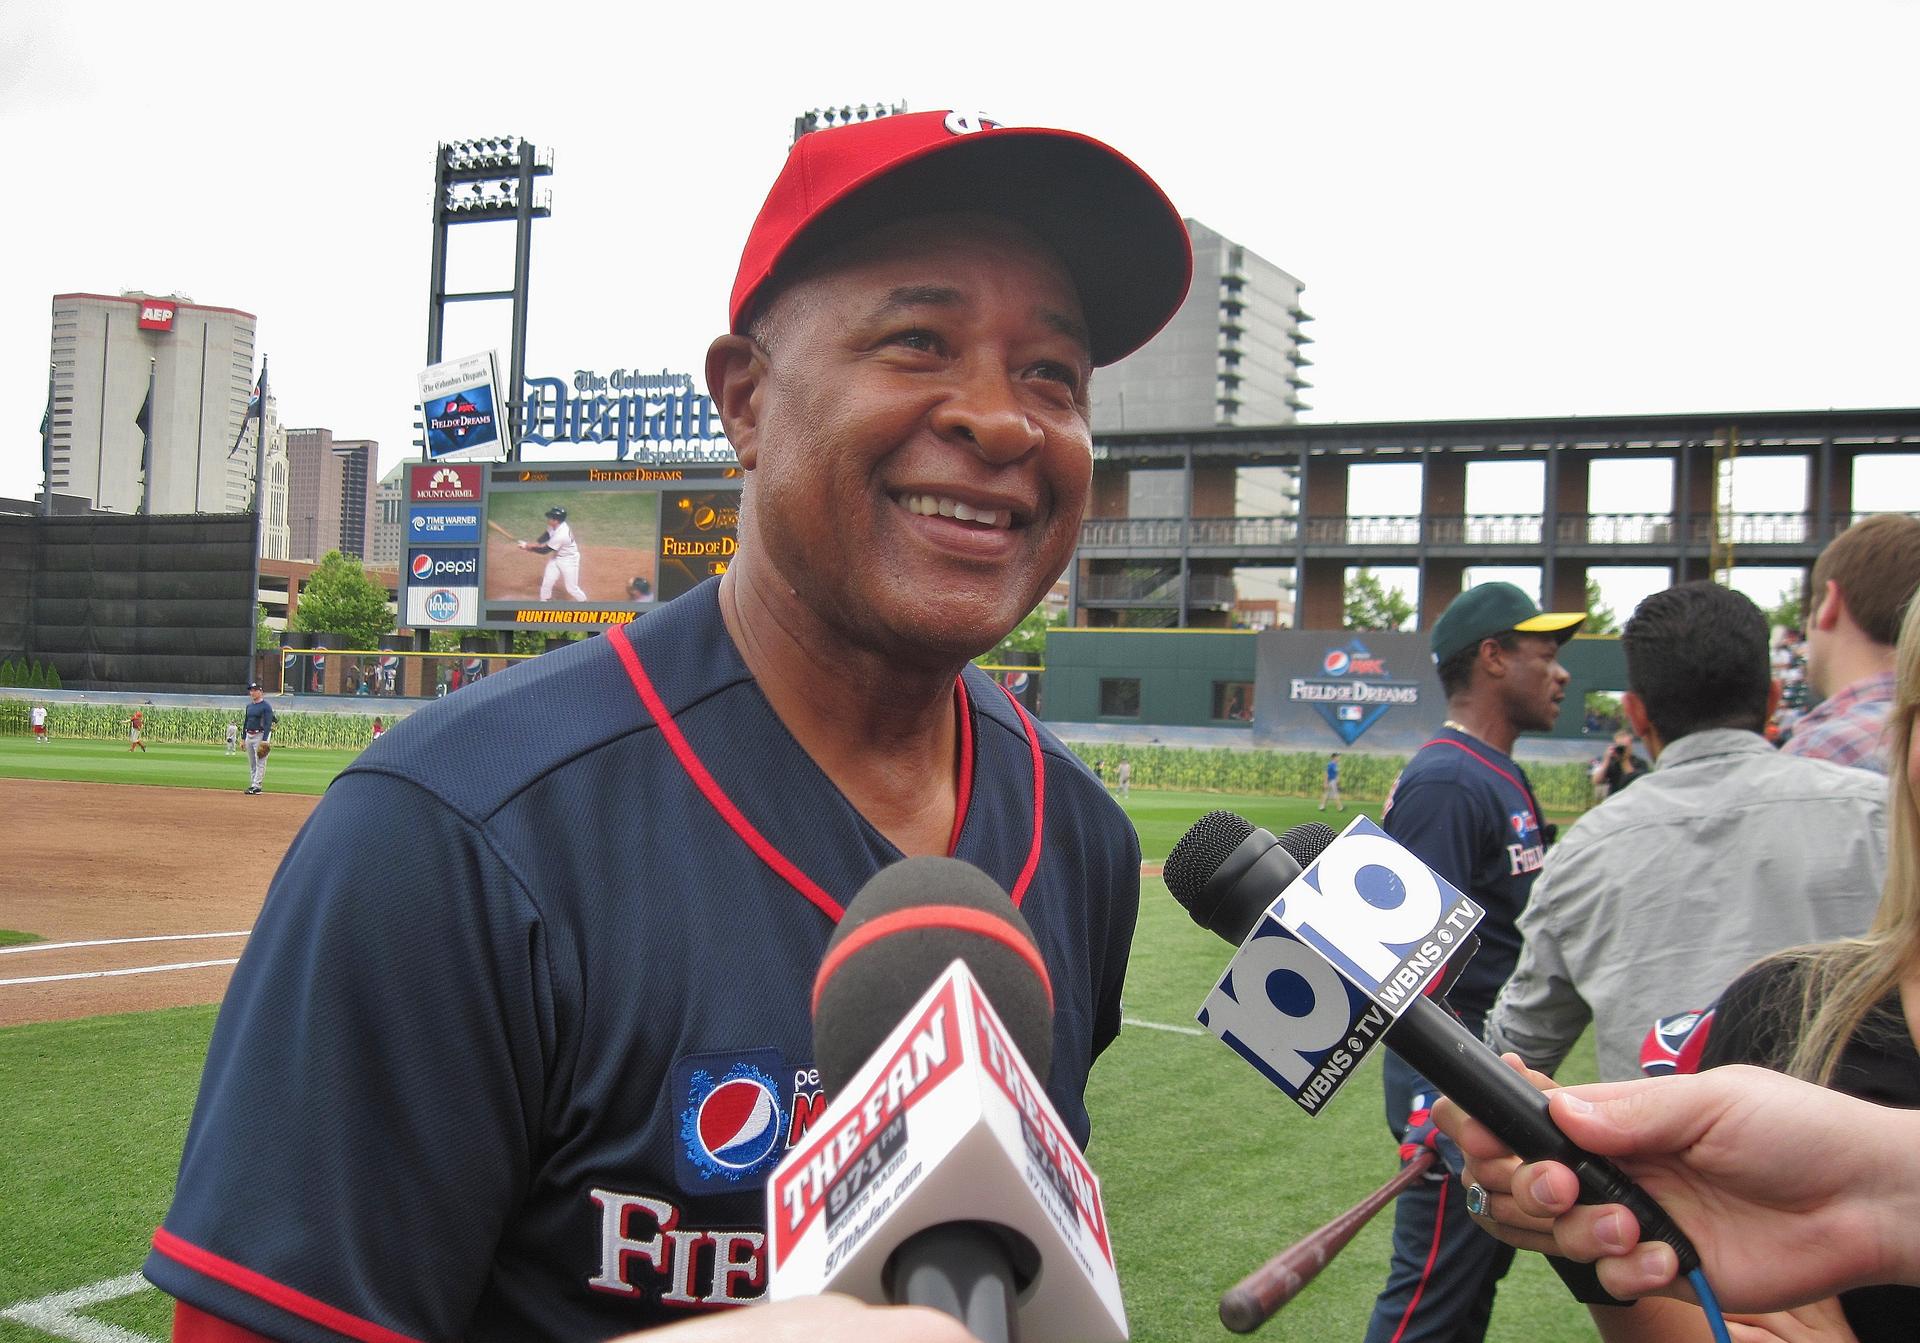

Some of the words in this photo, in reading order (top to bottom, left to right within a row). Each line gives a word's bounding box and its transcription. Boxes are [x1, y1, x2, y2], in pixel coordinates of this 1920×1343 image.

[142, 308, 174, 322] AEP
[574, 370, 607, 391] The
[610, 368, 692, 390] Columbus
[431, 419, 452, 429] FIELD
[460, 415, 491, 426] DREAMS
[516, 375, 727, 461] Dispatc
[589, 469, 622, 482] FIELD
[623, 471, 635, 481] OF
[636, 467, 682, 482] DREAMS
[417, 490, 444, 498] MOUNT
[445, 490, 474, 498] CARMEL
[427, 516, 444, 524] TIME
[445, 516, 477, 524] WARNER
[663, 537, 704, 556] FIELD
[705, 542, 720, 554] OF
[435, 558, 476, 576] pepsi
[430, 594, 458, 619] Kroger
[516, 610, 599, 624] HUNTINGTON
[600, 611, 637, 624] PARK
[1290, 679, 1337, 701] FIELD
[1352, 680, 1418, 703] DREAMS
[1379, 941, 1443, 1007] WBNS
[1445, 899, 1477, 931] TV
[1298, 1050, 1353, 1111] WBNS
[1355, 1004, 1387, 1039] TV
[783, 1114, 862, 1233] THE
[862, 1005, 948, 1135] FAN
[880, 1117, 904, 1149] FM
[828, 1193, 870, 1245] SPORTS
[871, 1150, 908, 1198] RADIO
[824, 1161, 923, 1279] 971thefan.com
[587, 1187, 770, 1309] FIE
